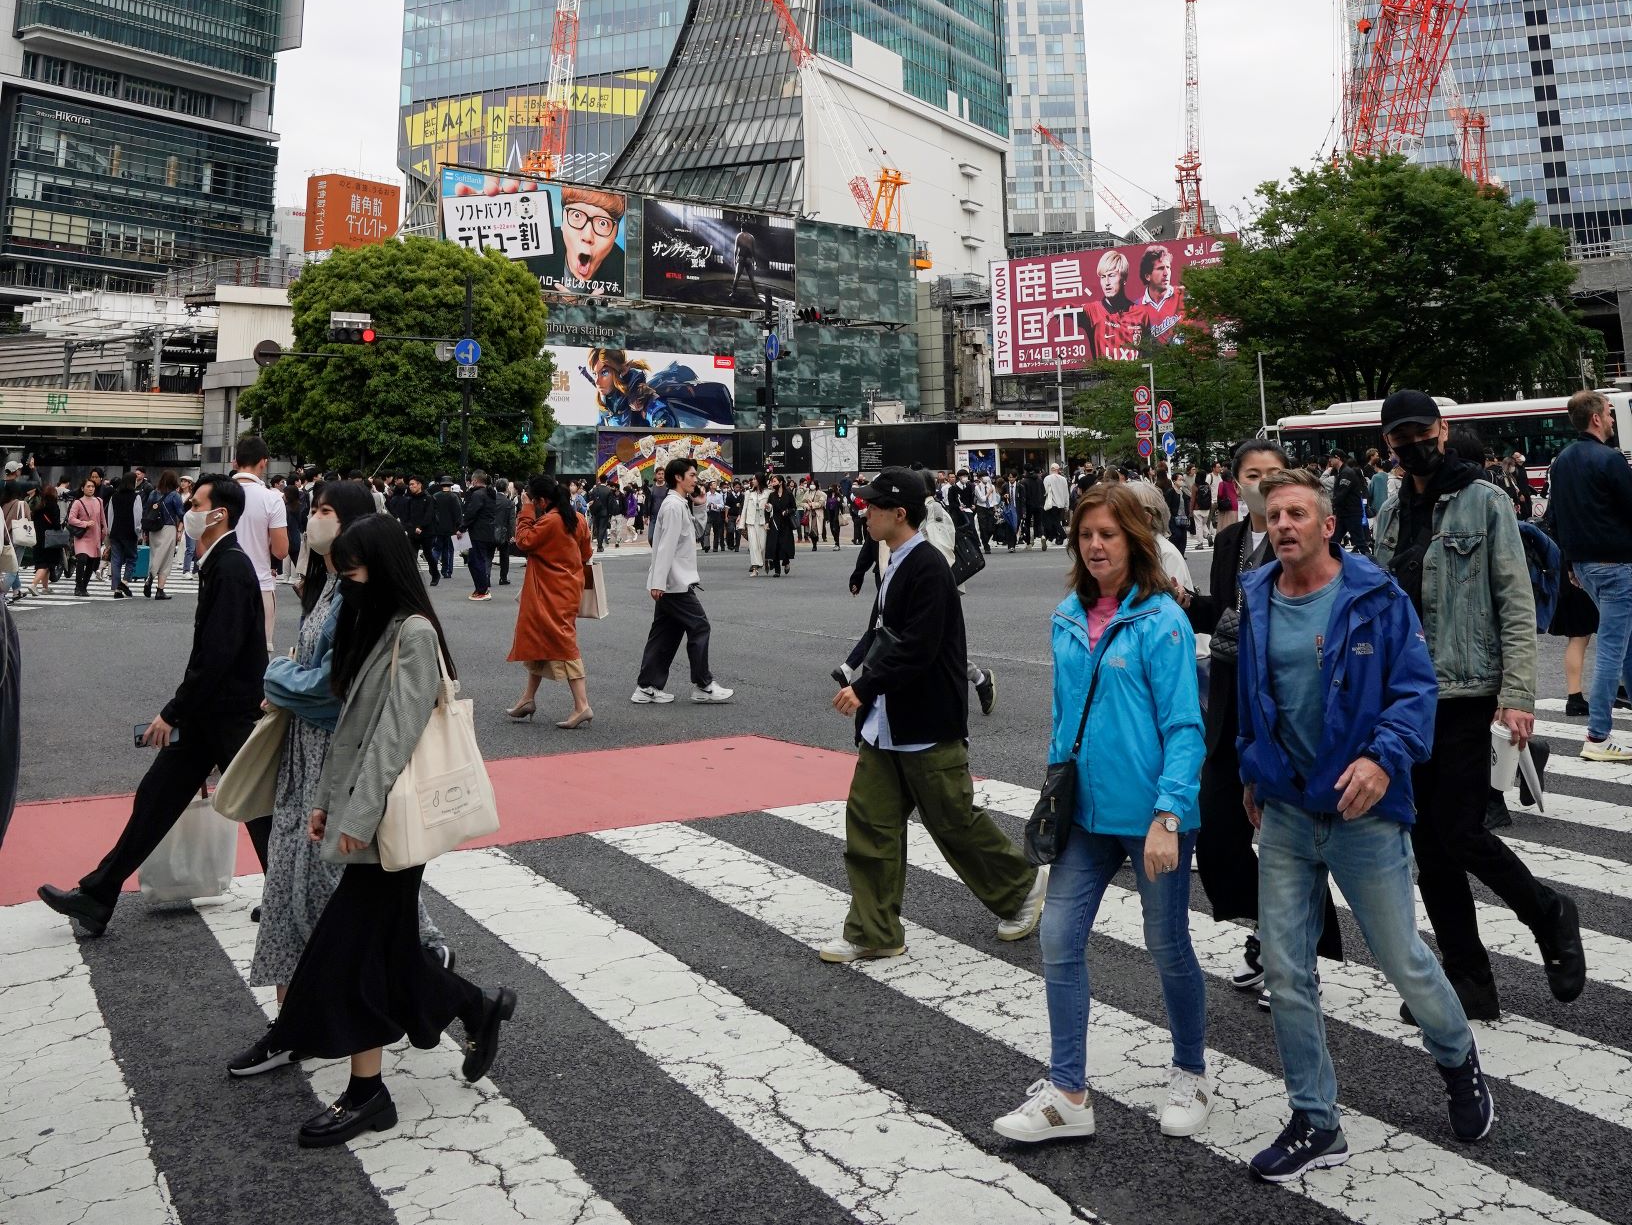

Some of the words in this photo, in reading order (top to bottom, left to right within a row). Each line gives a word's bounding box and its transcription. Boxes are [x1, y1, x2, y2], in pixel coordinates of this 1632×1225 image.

[579, 93, 595, 107] A8
[55, 111, 90, 125] Hikarie
[442, 112, 463, 132] A4
[455, 173, 482, 184] SoftBank
[350, 193, 383, 217] 龍角散
[456, 202, 511, 221] ソフトバンク
[345, 214, 387, 238] ダイレクト
[995, 267, 1007, 301] NOW
[996, 305, 1007, 325] ON
[1017, 305, 1085, 345] 国立
[580, 325, 614, 337] station
[997, 330, 1009, 369] SALE
[1055, 344, 1086, 358] 13:30
[46, 393, 69, 414] 駅
[548, 395, 570, 403] INGDOM
